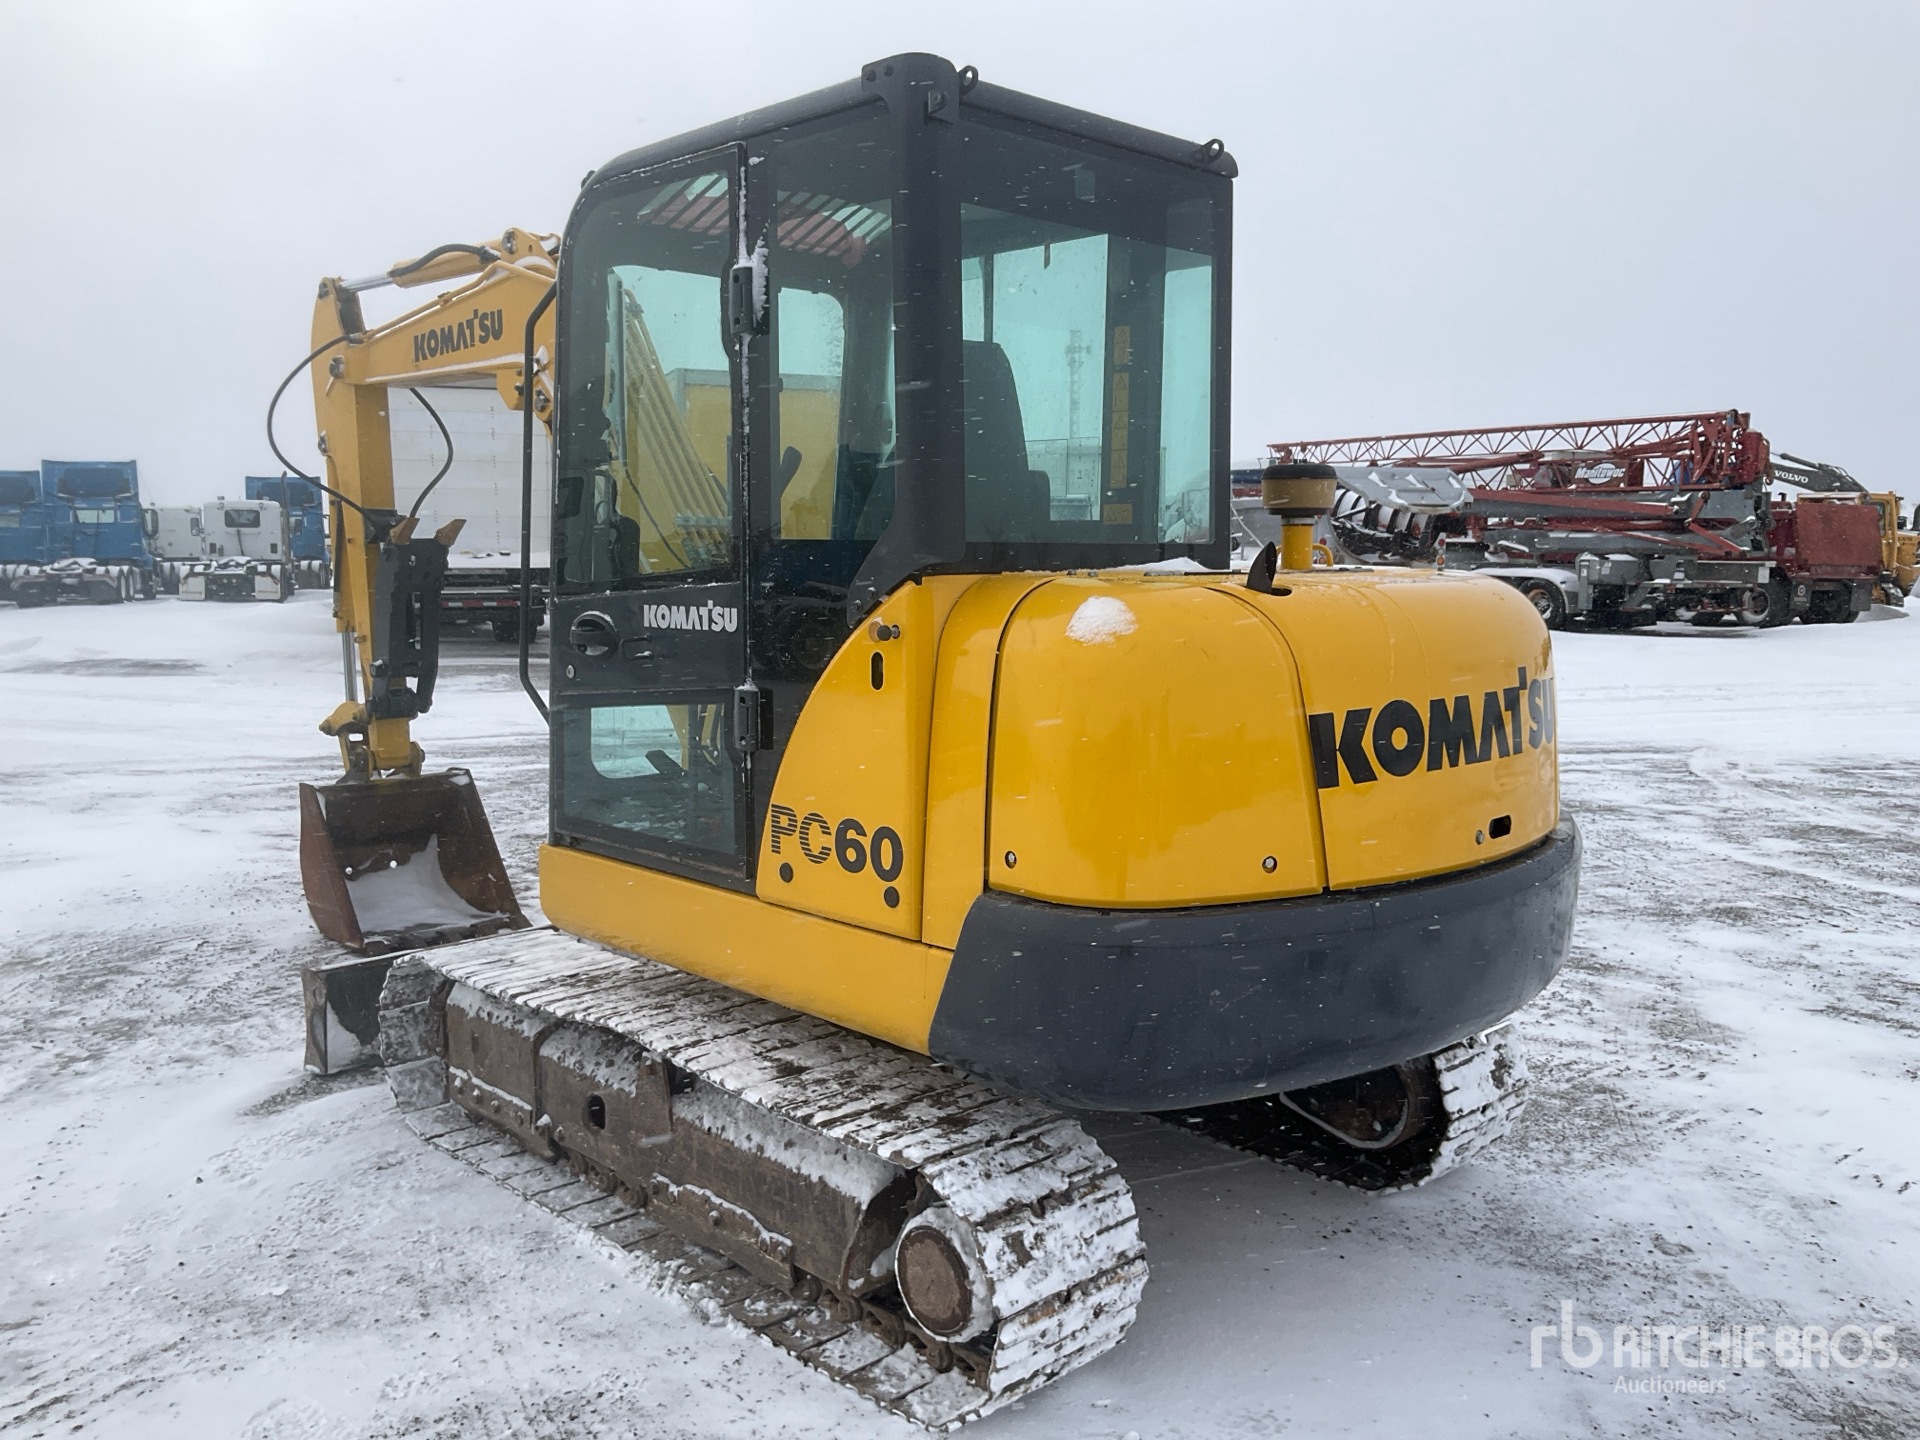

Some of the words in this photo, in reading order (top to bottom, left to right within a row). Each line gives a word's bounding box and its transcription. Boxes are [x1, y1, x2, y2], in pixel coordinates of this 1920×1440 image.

[413, 308, 504, 363] KOMATSU
[1574, 466, 1626, 479] Manitowoc
[1774, 469, 1809, 484] VOLVO
[643, 600, 738, 632] KOMATSU
[1308, 666, 1556, 789] KOMATSU
[770, 803, 904, 882] PC60
